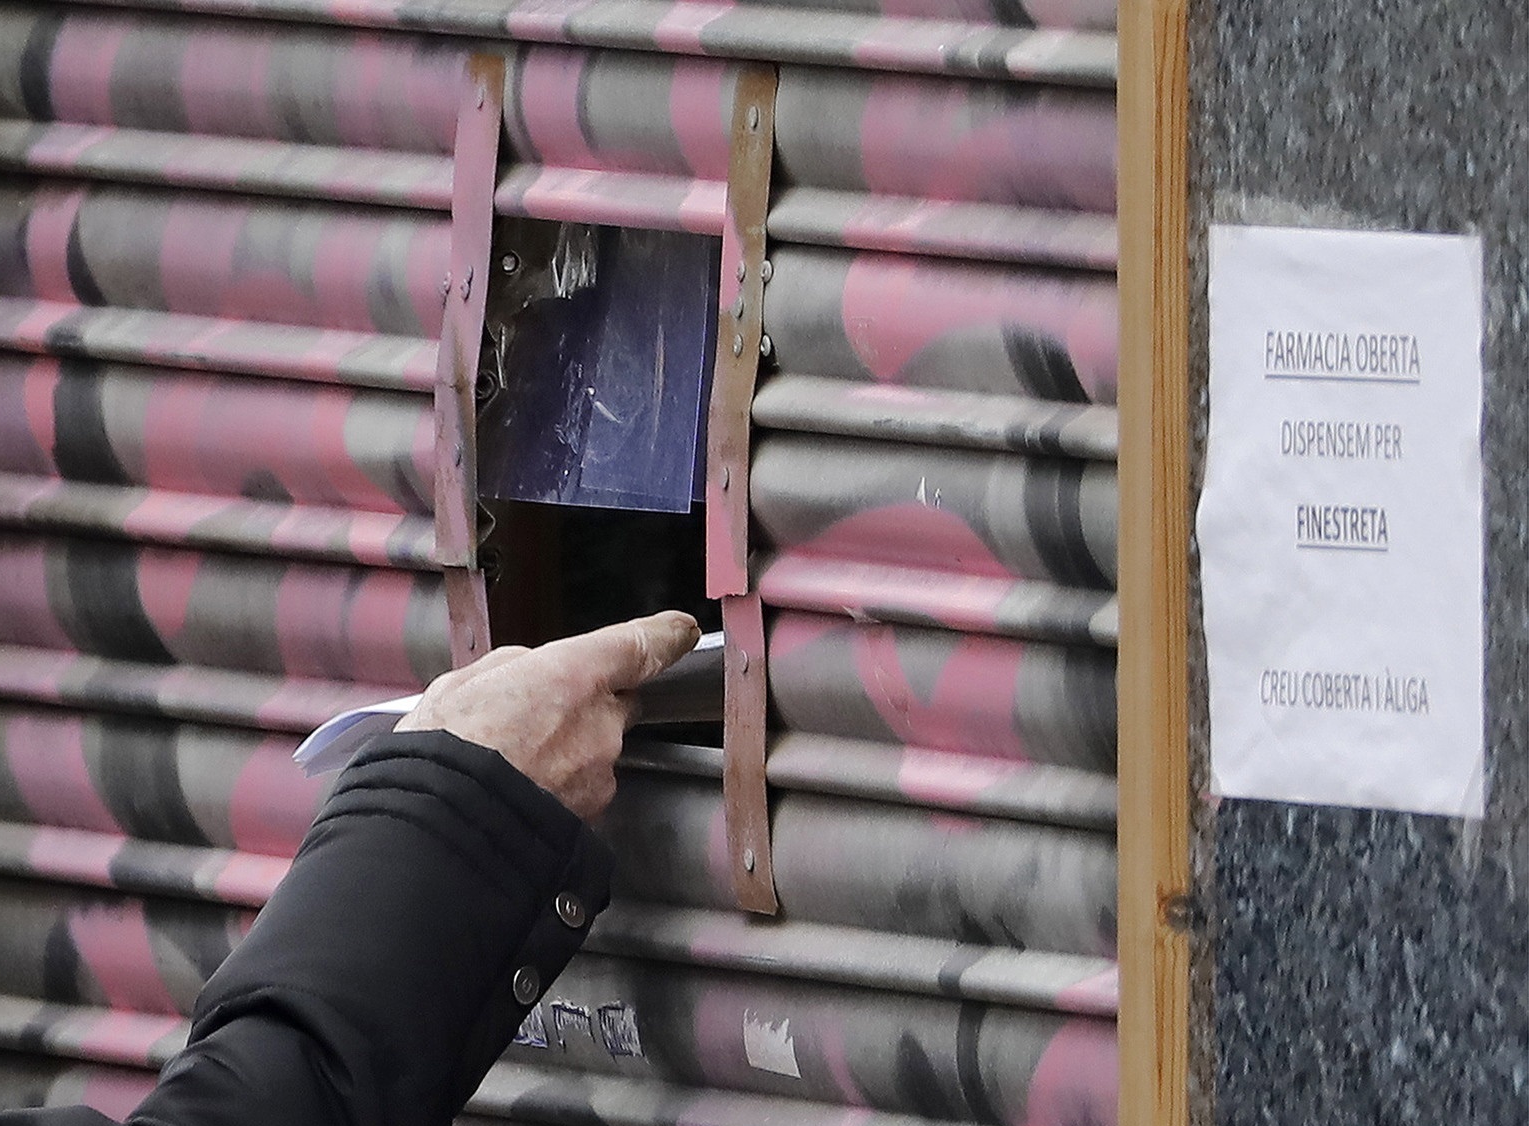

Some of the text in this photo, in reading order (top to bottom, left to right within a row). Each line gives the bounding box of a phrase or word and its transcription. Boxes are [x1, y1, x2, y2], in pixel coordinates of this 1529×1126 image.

[1265, 331, 1421, 374] FARMACIA OBERTA
[1281, 420, 1403, 459] DISPENSEM PER
[1296, 504, 1389, 543] FINESTRETA
[1260, 669, 1298, 706] CREU
[1302, 671, 1372, 710] COBERTA
[1383, 666, 1430, 714] ÀLIGA
